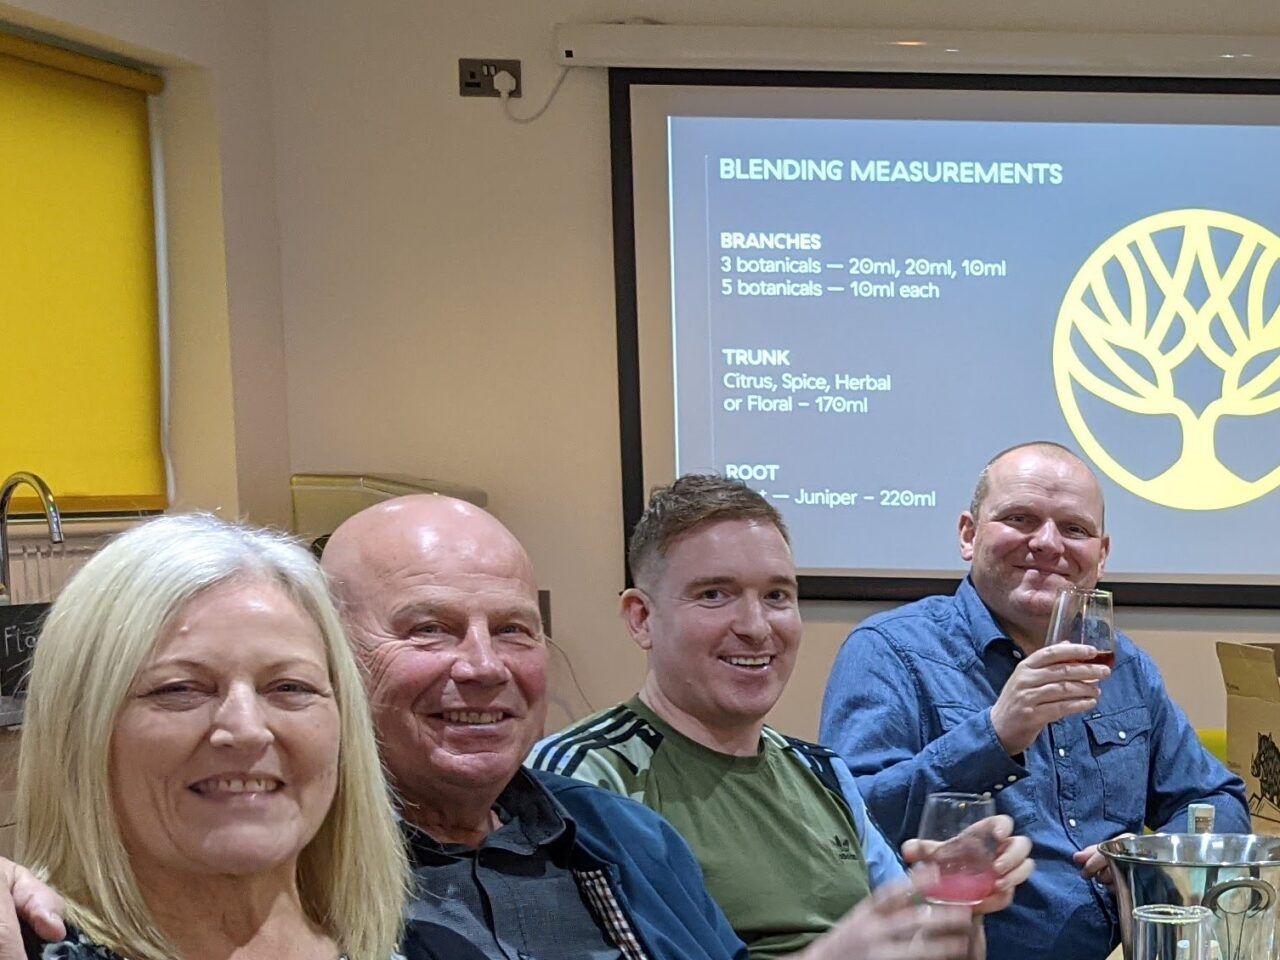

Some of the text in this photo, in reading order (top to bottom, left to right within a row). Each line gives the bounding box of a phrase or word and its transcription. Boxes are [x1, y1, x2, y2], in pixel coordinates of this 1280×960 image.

[719, 158, 1063, 185] BLENDING MEASUREMENTS
[720, 232, 822, 250] BRANCHES
[720, 256, 732, 273] 3
[736, 257, 822, 274] botanicals
[849, 258, 900, 278] 20ml,
[905, 258, 957, 279] 20ml,
[961, 259, 1007, 277] 10ml
[721, 279, 732, 295] 5
[737, 279, 823, 297] botanicals
[849, 281, 895, 298] 10ml
[899, 282, 940, 299] each
[722, 349, 790, 366] TRUNK
[723, 373, 891, 393] Citrus, Spice, Herbal
[723, 398, 743, 412] or
[747, 395, 793, 412] Floral
[815, 396, 868, 413] 170ml
[726, 464, 780, 481] ROOT
[795, 488, 858, 508] Juniper
[880, 490, 936, 507] 220ml
